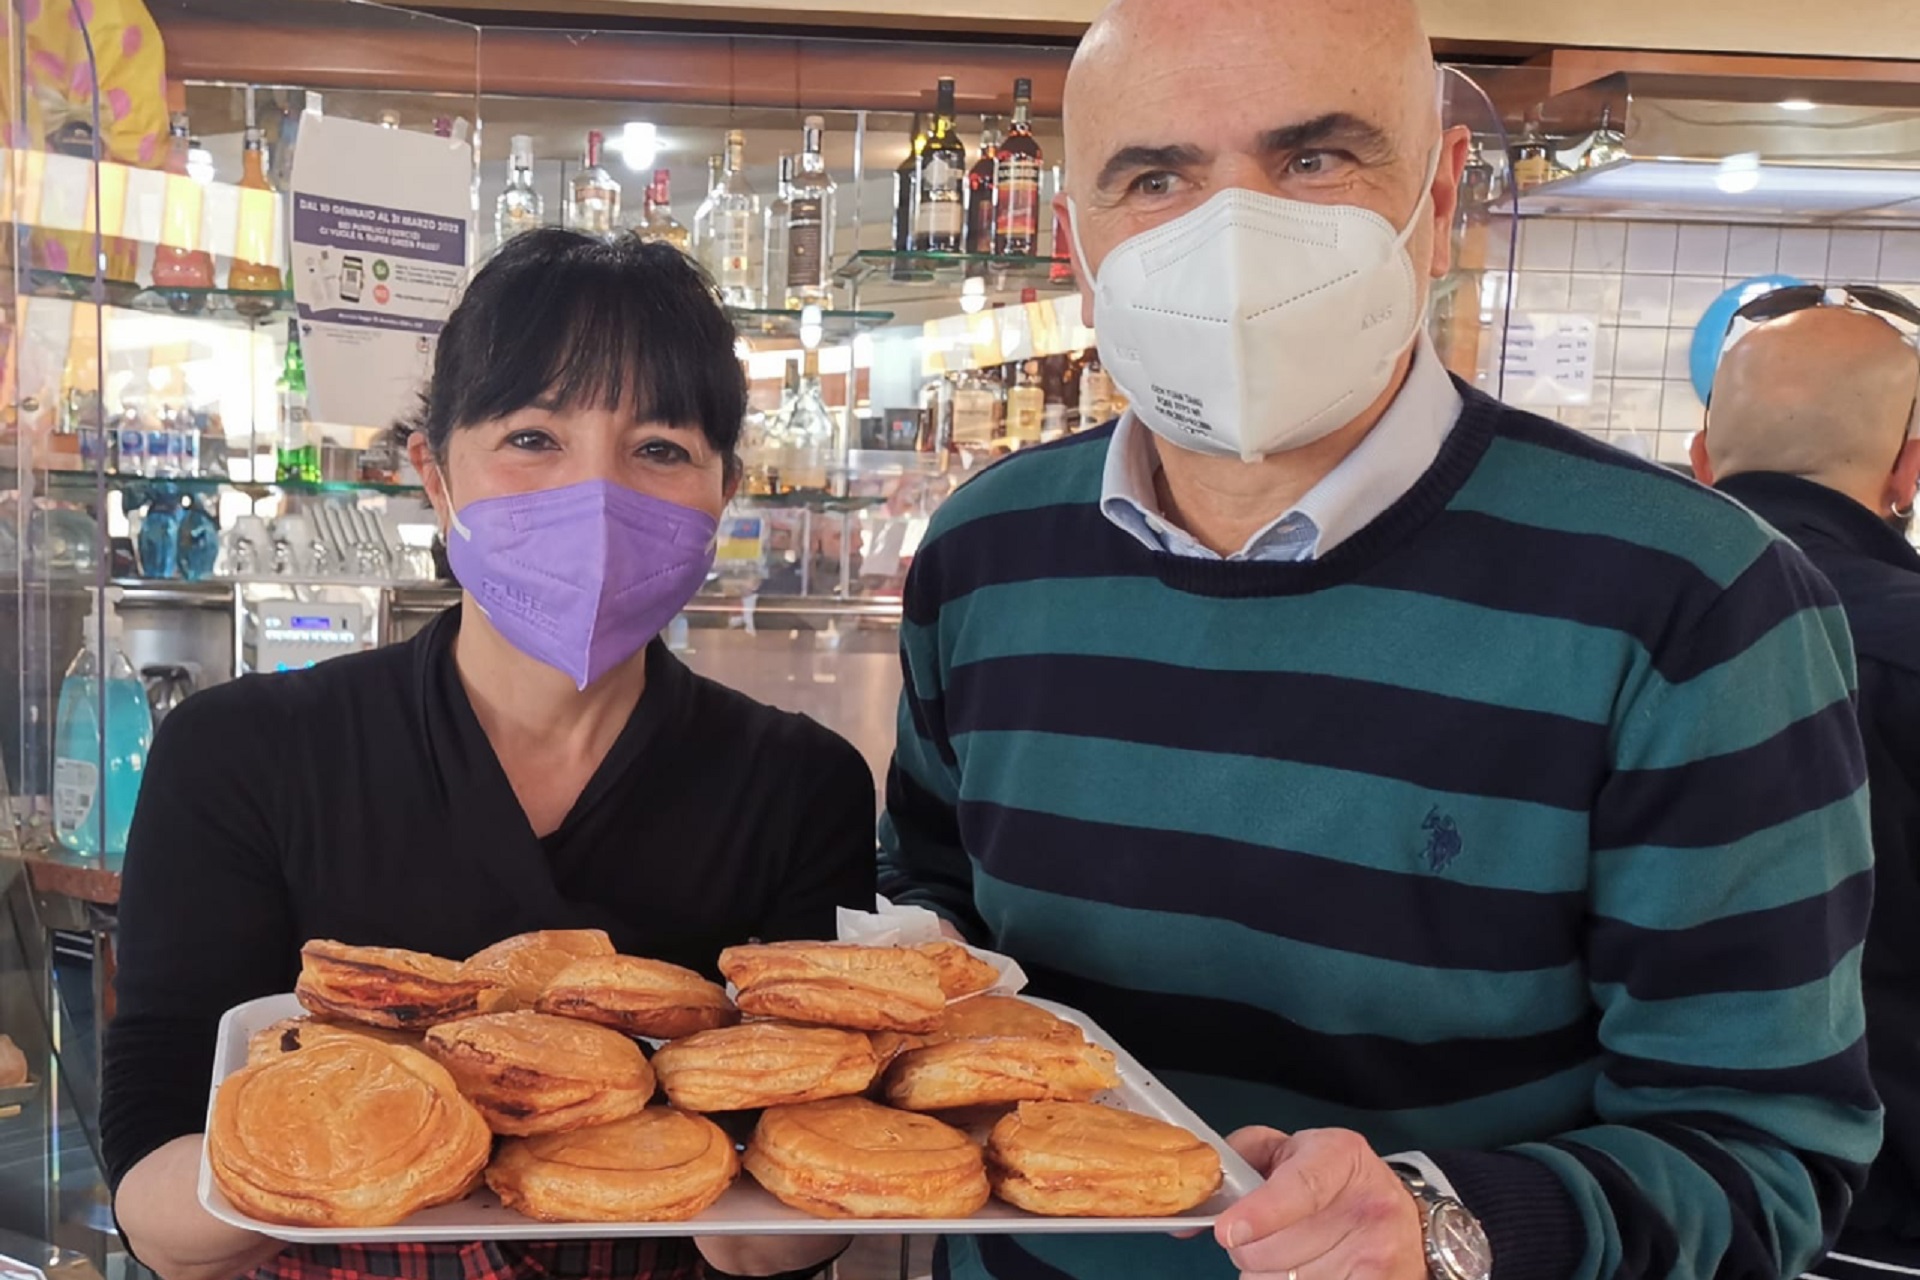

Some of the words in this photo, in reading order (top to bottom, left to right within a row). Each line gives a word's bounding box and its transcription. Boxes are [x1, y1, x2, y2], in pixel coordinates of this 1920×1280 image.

[299, 199, 318, 212] DAL
[332, 205, 375, 220] GENNAIO
[377, 212, 390, 223] AL
[402, 216, 436, 230] MARZO
[437, 221, 459, 233] 2022
